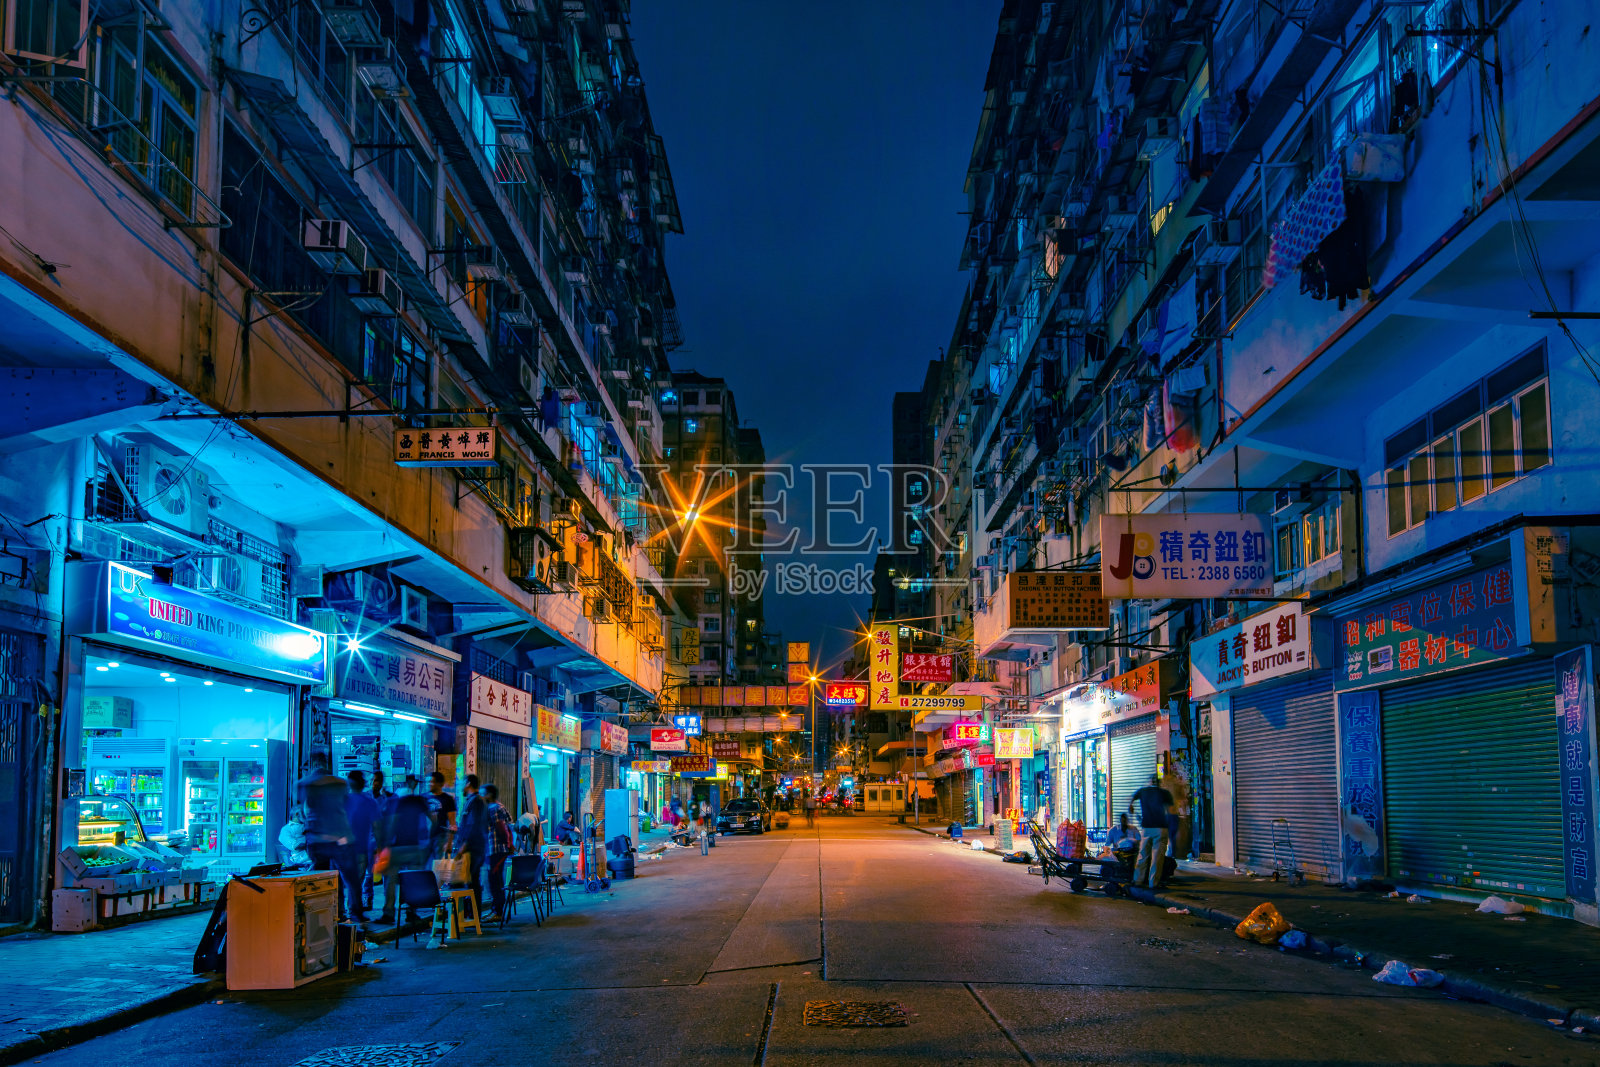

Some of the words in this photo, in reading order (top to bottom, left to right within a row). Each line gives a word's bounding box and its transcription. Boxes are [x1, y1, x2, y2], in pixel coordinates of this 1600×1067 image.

[1198, 566, 1230, 580] 2388
[1233, 566, 1265, 580] 6580
[148, 597, 194, 628] UNITED
[196, 612, 224, 636] KING
[1342, 568, 1513, 647] 昭和電位保健
[1398, 617, 1513, 671] 器材中心
[1216, 664, 1249, 684] JACKY'S
[1252, 649, 1292, 673] BUTTON
[388, 688, 417, 706] TRADING
[420, 696, 445, 713] COMPANY
[911, 698, 965, 708] 27299799
[1562, 670, 1589, 880] 健康就是財富
